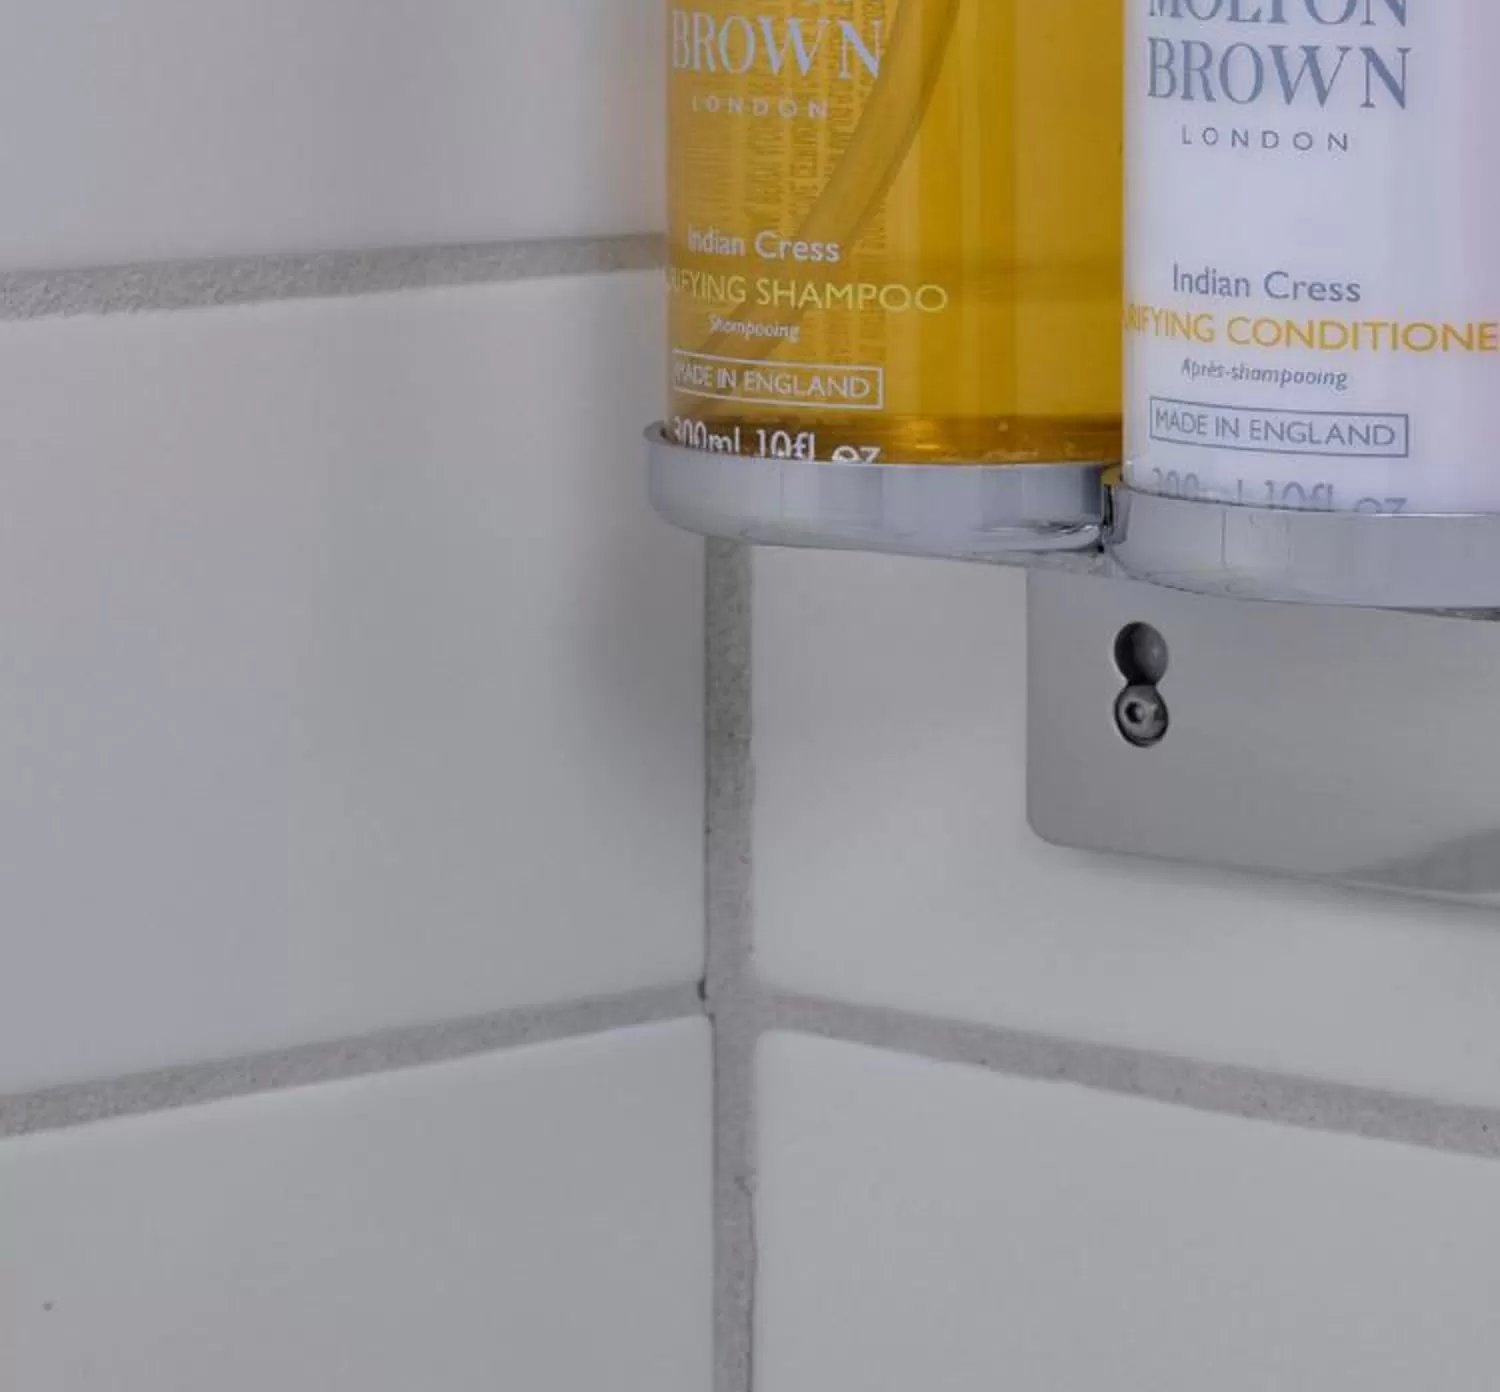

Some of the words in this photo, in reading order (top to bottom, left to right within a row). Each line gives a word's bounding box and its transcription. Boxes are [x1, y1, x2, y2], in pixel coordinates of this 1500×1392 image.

[672, 9, 884, 80] BROWN
[1147, 36, 1412, 110] BROWN
[1181, 125, 1348, 153] LONDON
[687, 229, 745, 256] Indian
[755, 231, 840, 263] Cress
[756, 277, 949, 314] SHAMPOO
[1173, 263, 1250, 298] Indian
[1264, 270, 1361, 303] Cress
[717, 367, 737, 389] IN
[743, 369, 871, 399] ENGLAND
[1181, 356, 1349, 391] Après-shampooing
[1155, 407, 1207, 437] MADE
[1215, 414, 1241, 439] IN
[1250, 418, 1396, 447] ENGLAND
